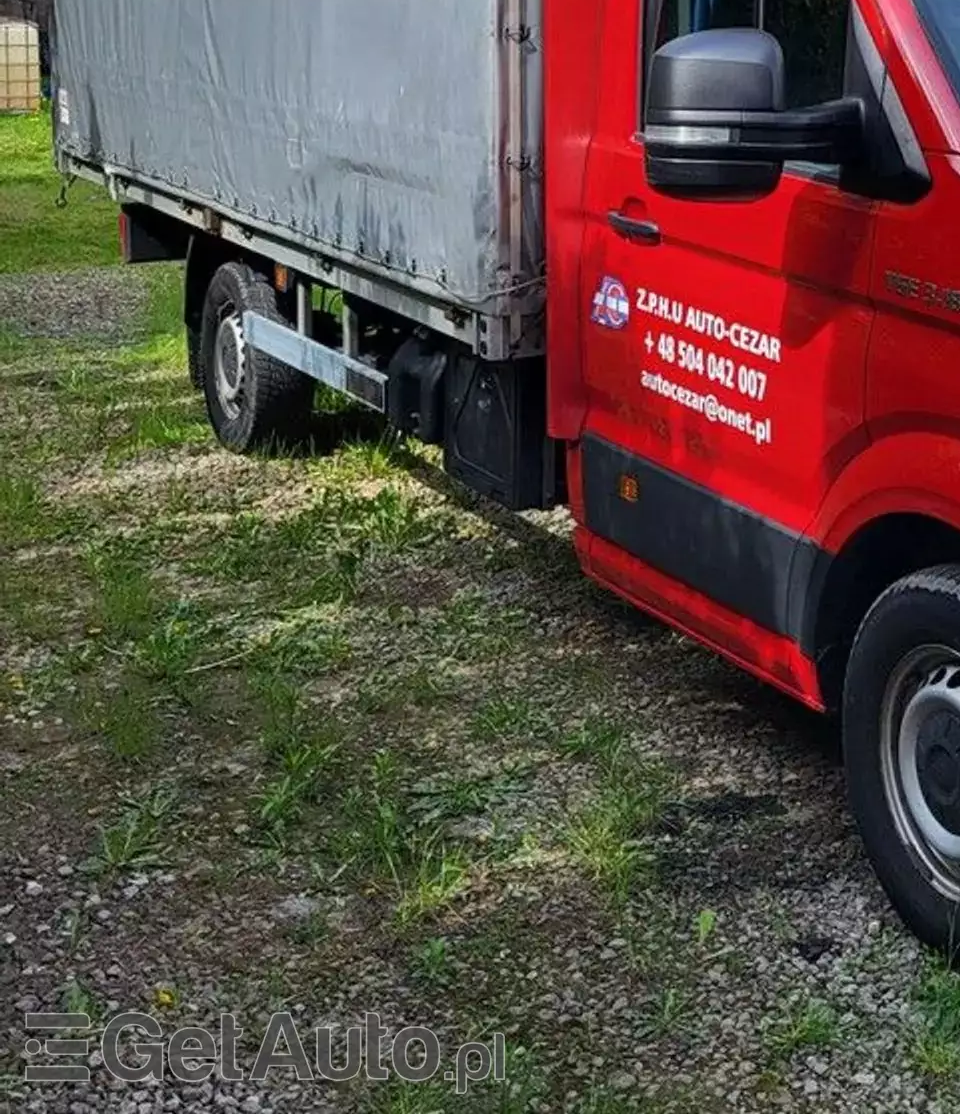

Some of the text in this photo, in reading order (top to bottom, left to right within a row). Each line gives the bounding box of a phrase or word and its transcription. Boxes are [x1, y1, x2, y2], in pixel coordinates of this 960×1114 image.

[636, 288, 781, 362] Z.P.H.U AUTO-CEZAR
[658, 333, 675, 363] 48
[678, 340, 704, 375] 504
[707, 353, 734, 389] 042
[738, 365, 767, 401] 007
[640, 370, 771, 444] autocezar@onet.pl
